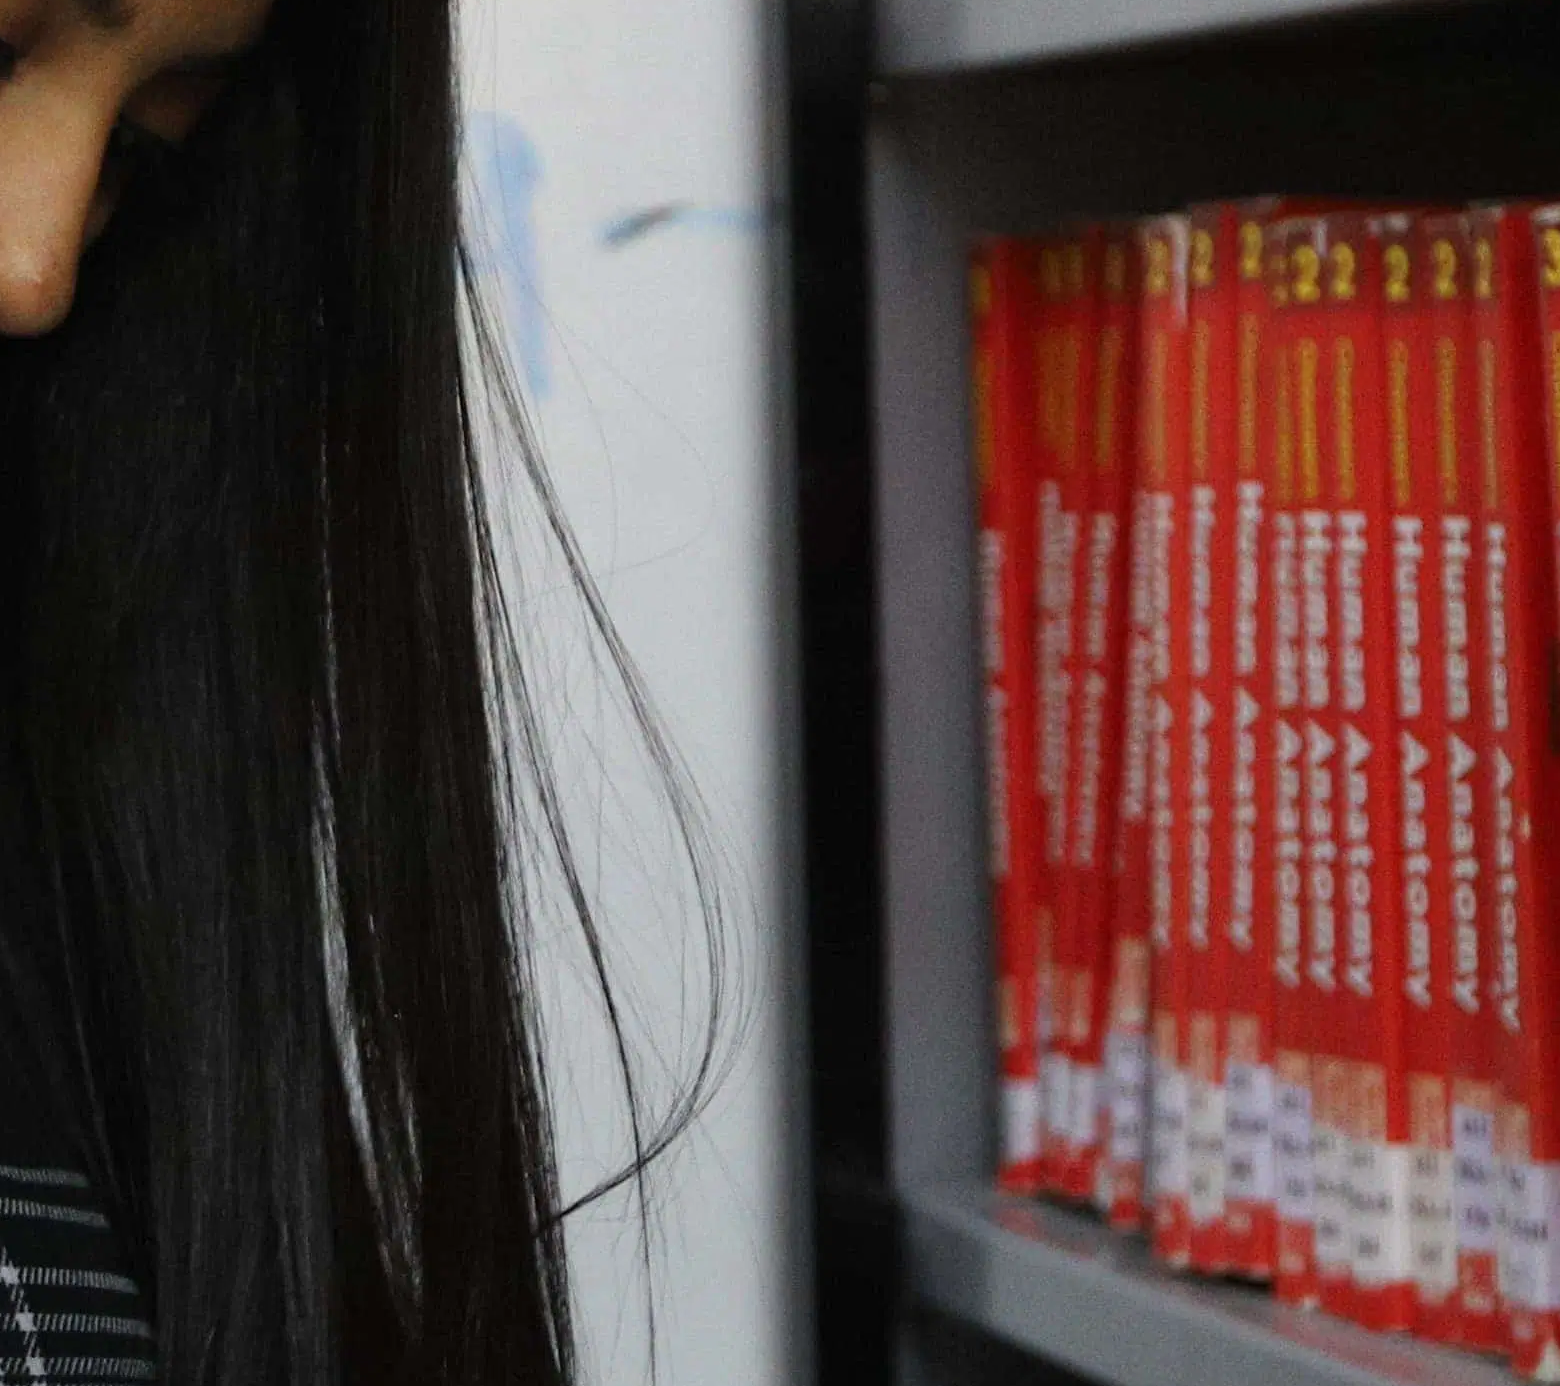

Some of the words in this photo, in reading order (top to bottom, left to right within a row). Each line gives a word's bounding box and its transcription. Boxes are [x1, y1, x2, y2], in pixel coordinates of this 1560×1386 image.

[1302, 510, 1332, 708] Human
[1338, 510, 1367, 710] Human
[1393, 515, 1423, 719] Human
[1441, 515, 1472, 720] Human
[1304, 718, 1336, 990] Anatomy
[1340, 722, 1373, 998] Anatomy
[1399, 728, 1432, 1007] Anatomy
[1446, 732, 1480, 1012] Anatomy
